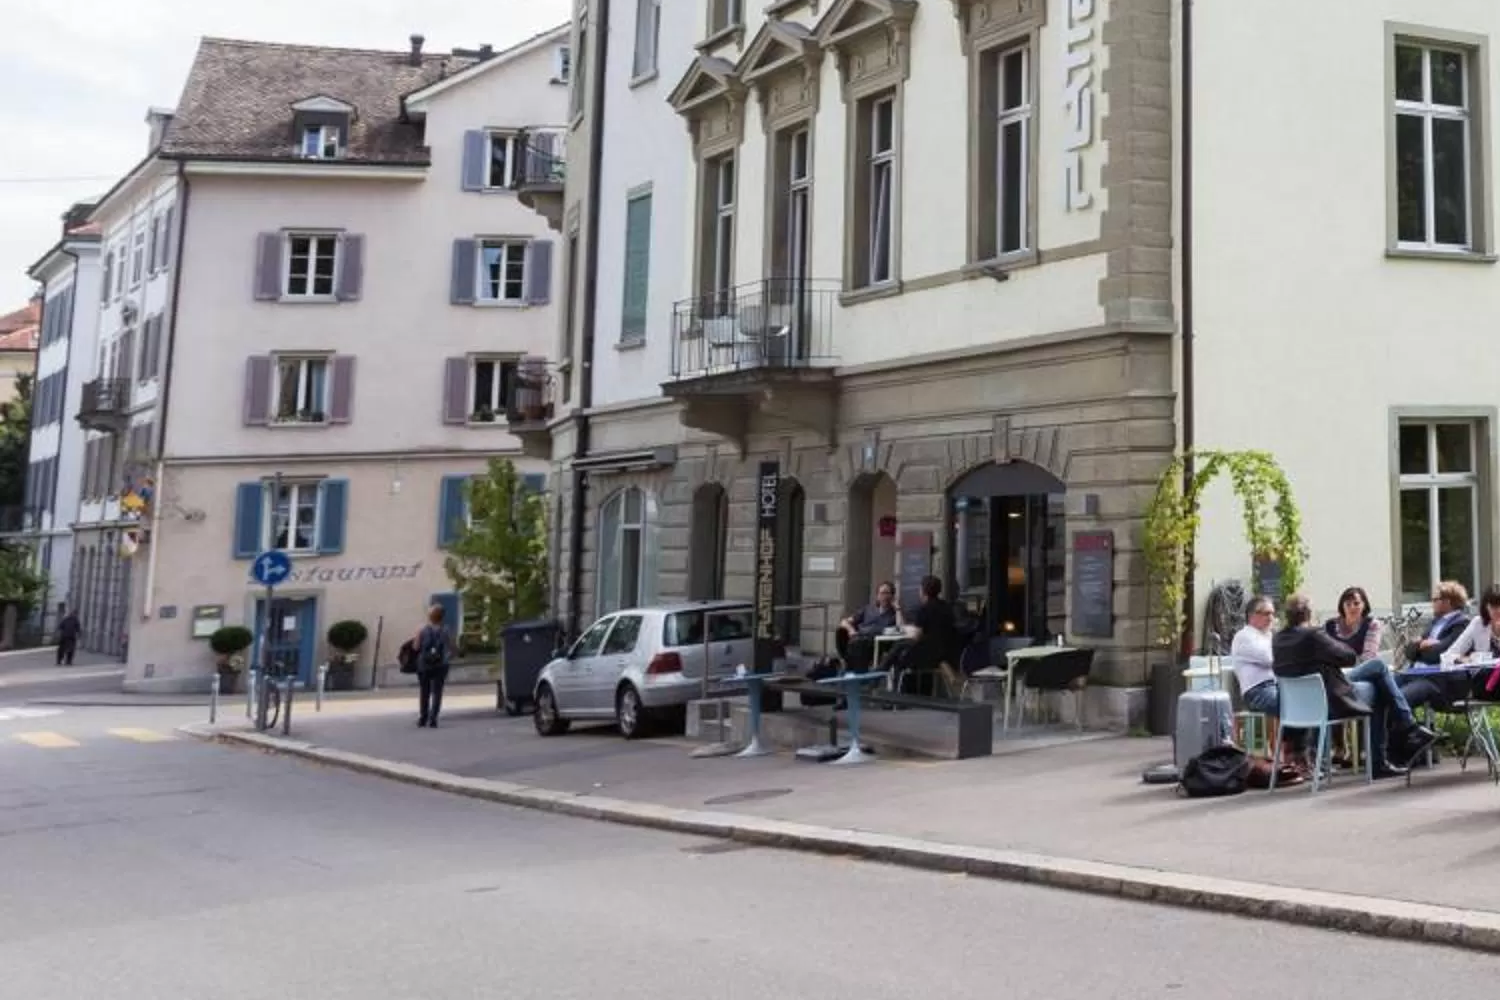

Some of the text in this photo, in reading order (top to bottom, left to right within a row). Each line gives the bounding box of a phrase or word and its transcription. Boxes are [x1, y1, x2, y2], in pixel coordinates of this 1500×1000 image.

[247, 560, 422, 585] staurant
[758, 473, 776, 640] PLATTENHOF HOTEL
